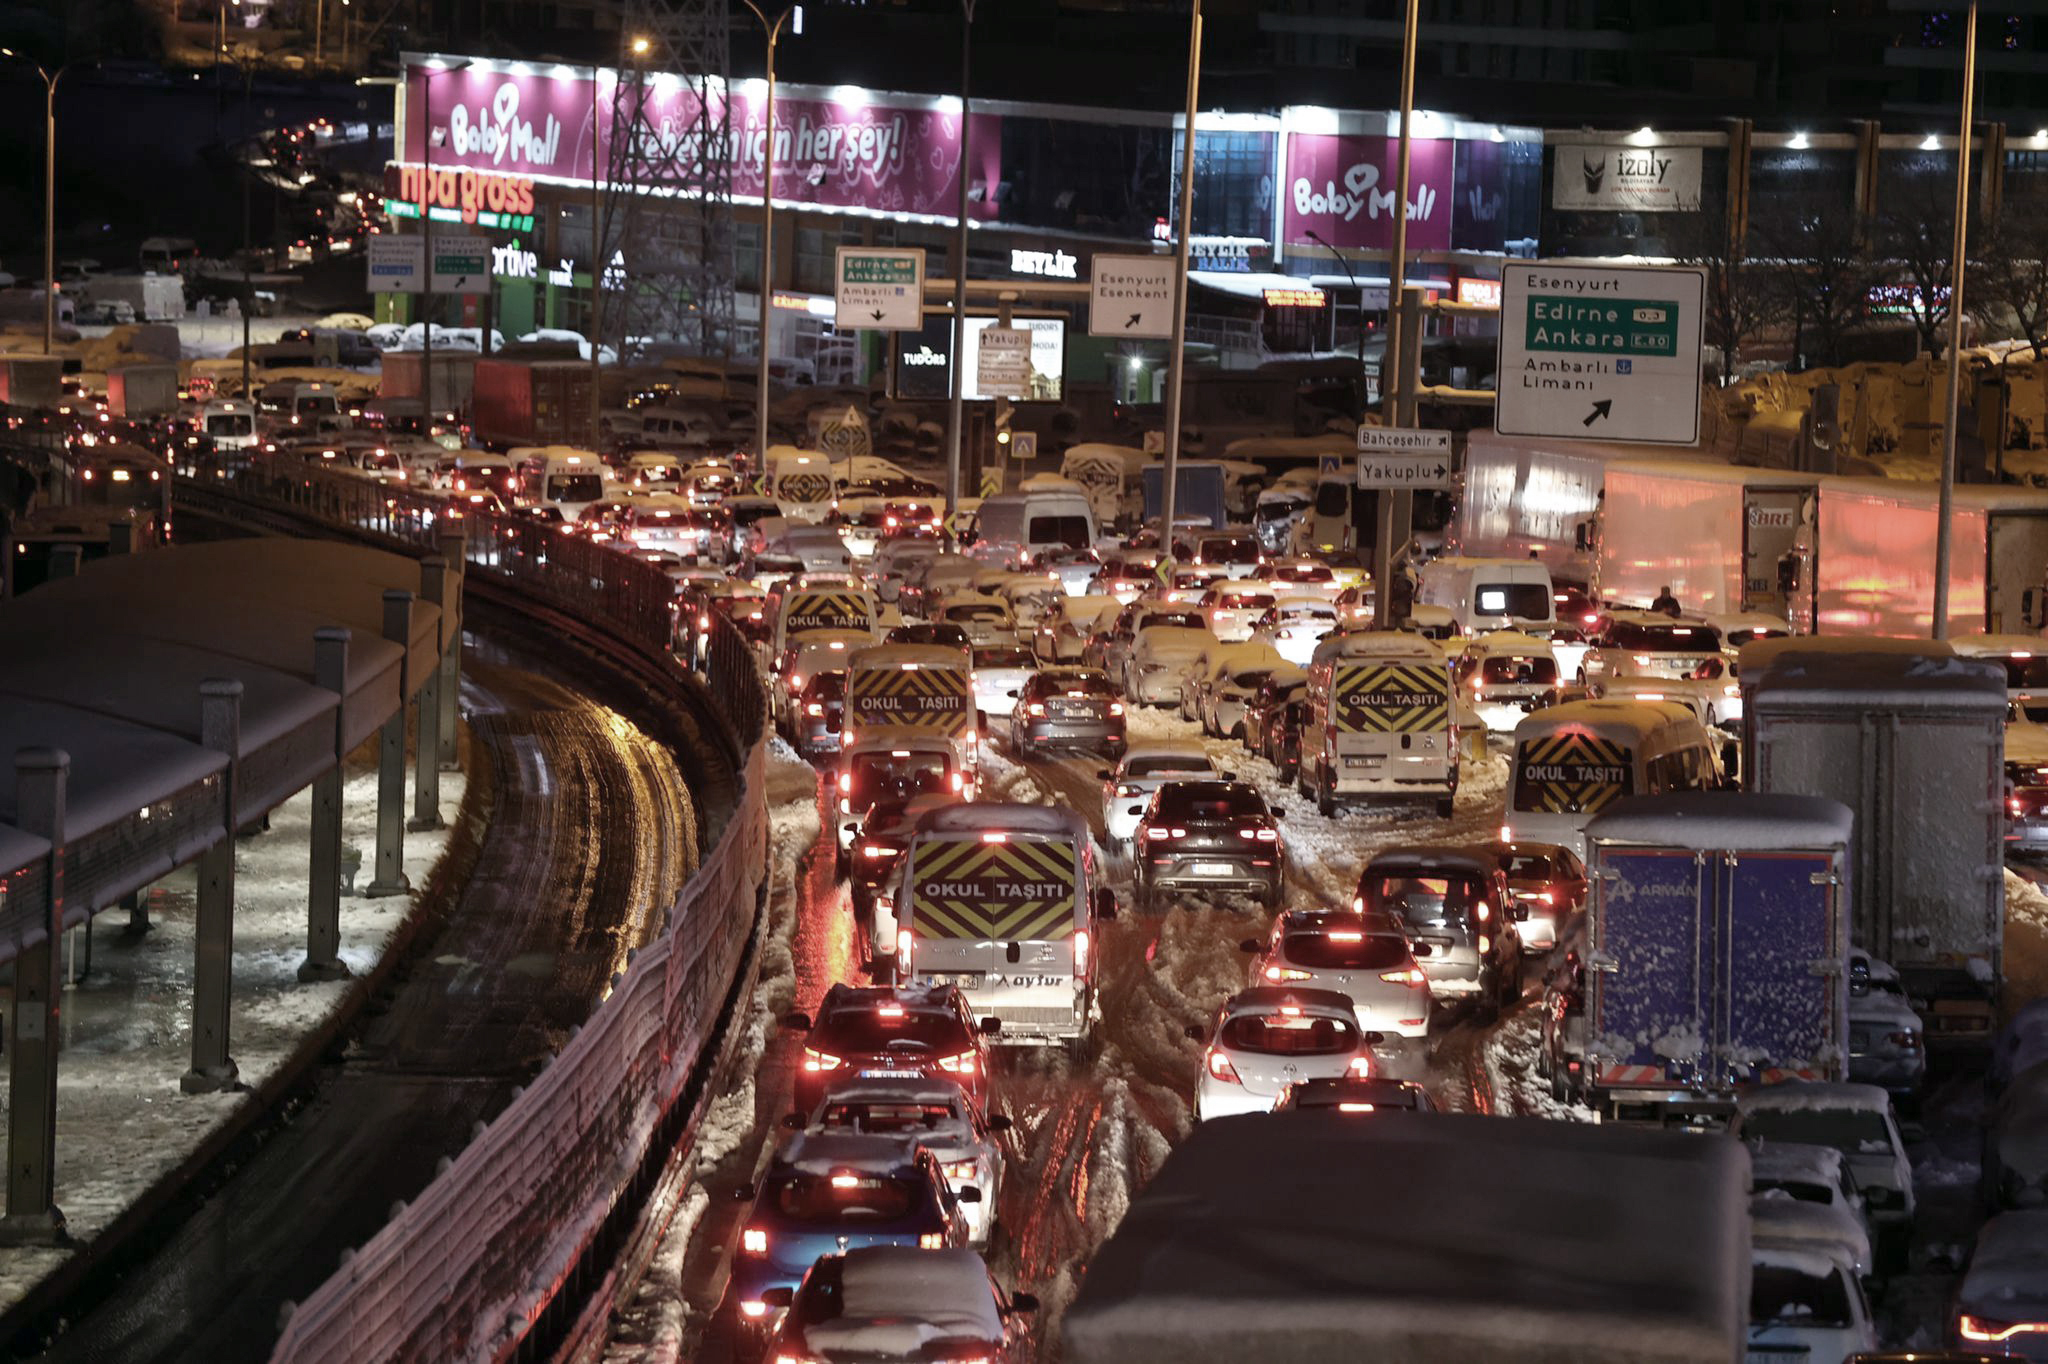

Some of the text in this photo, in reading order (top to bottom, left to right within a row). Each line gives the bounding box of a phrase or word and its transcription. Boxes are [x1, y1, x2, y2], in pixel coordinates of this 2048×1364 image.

[451, 100, 560, 165] Baby Mall
[797, 117, 841, 160] her
[846, 117, 901, 172] şey!
[1617, 150, 1672, 184] izoly
[460, 170, 534, 224] gross
[1293, 177, 1364, 221] Baby
[1369, 185, 1436, 221] Mall
[847, 259, 889, 269] Edirne
[847, 271, 892, 281] Ankara
[1101, 273, 1167, 285] Esenyurt
[1528, 275, 1619, 292] Esenyurt
[843, 287, 892, 296] Ambarlı
[1100, 287, 1168, 299] Esenkent
[842, 297, 884, 305] Limanı
[1534, 302, 1618, 322] Edirne
[1534, 327, 1624, 347] Ankara
[903, 353, 946, 366] TUDORS
[1524, 358, 1608, 374] Ambarlı
[1523, 375, 1593, 390] Limanı
[1363, 432, 1431, 447] Bahçeşehir
[1364, 464, 1430, 482] Yakuplu
[788, 615, 869, 628] OKUL TAŞITI
[861, 696, 959, 710] OKUL TAŞITI
[1349, 694, 1438, 706] OKUL TAŞITI
[1525, 765, 1624, 782] OKUL TAŞITI
[925, 883, 1063, 900] OKUL TAŞITI
